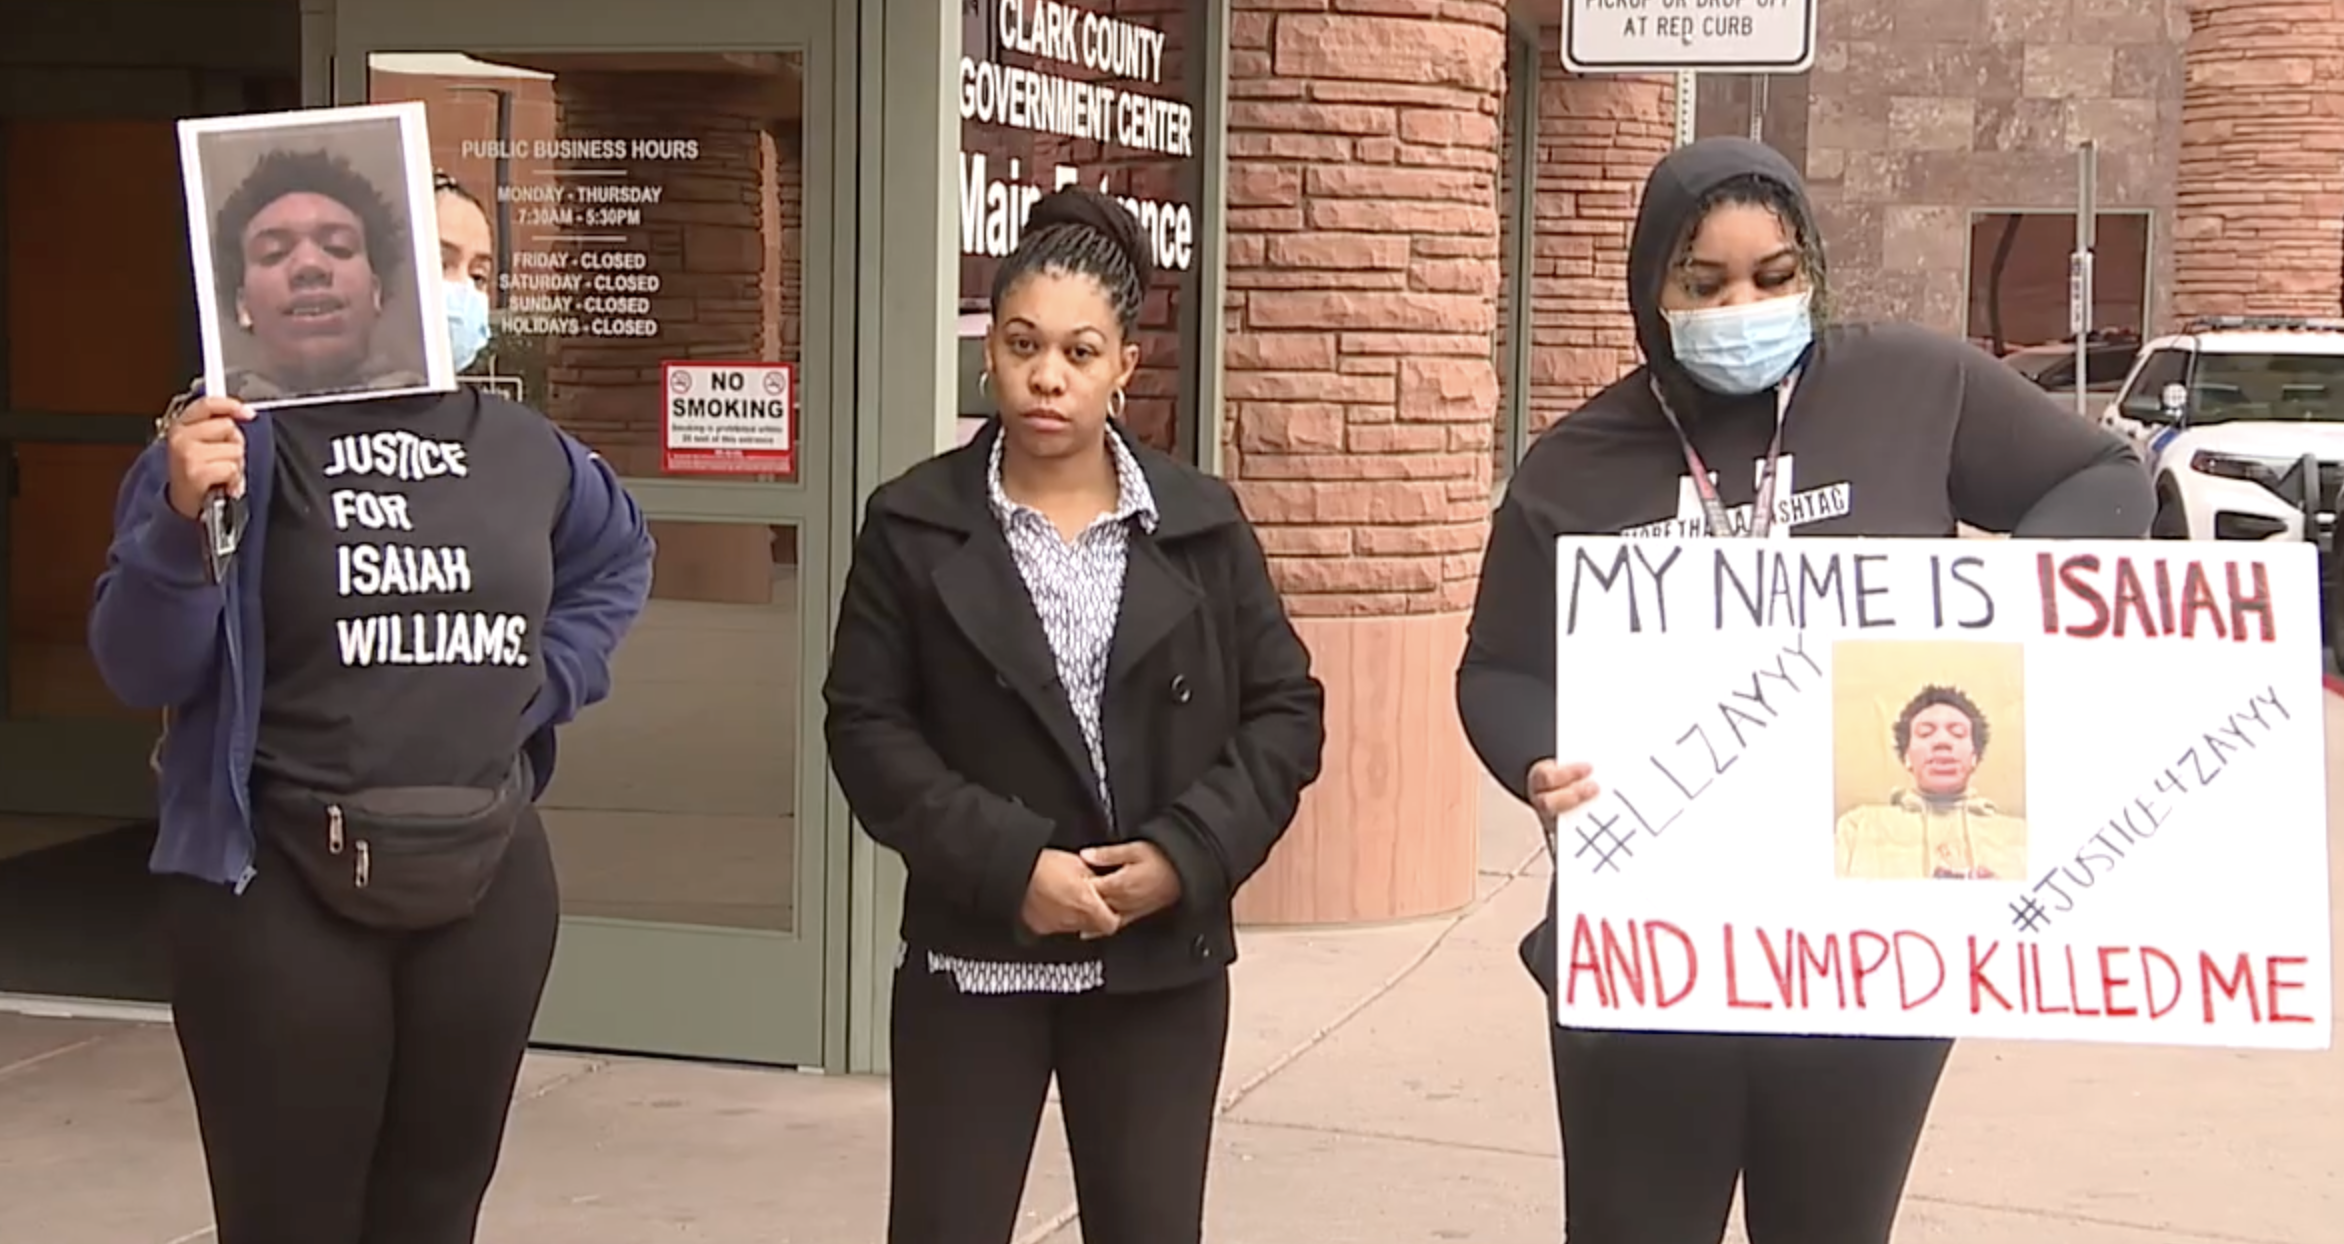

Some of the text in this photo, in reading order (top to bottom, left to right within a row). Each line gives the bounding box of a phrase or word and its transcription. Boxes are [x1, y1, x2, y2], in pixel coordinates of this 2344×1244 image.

[1624, 16, 1753, 37] AT RED CURB
[1000, 0, 1165, 84] CLARK COUNTY
[960, 56, 1193, 157] GOVERNMENT CENTER
[461, 139, 699, 160] PUBLIC BUSINESS HOURS
[498, 186, 564, 203] MONDAY
[577, 186, 662, 203] THURSDAY
[518, 208, 574, 225] 7:30AM
[585, 208, 641, 226] 5:30PM
[513, 252, 568, 269] FRIDAY
[580, 252, 646, 270] CLOSED
[500, 273, 582, 291] SATURDAY
[594, 274, 660, 292] CLOSED
[509, 295, 573, 313] SUNDAY
[584, 296, 650, 314] CLOSED
[502, 317, 579, 335] HOLIDAYS
[592, 318, 658, 336] CLOSED
[711, 371, 745, 391] NO
[673, 397, 784, 419] SMOKING
[324, 430, 469, 481] JUSTICE
[332, 489, 413, 531] FOR
[338, 544, 471, 596] ISAIAH
[1566, 544, 2277, 643] MY NAME IS ISAIAH
[337, 611, 529, 667] WILLIAMS.
[2008, 685, 2291, 934] #JUSTICE4ZAYYY
[1567, 912, 2316, 1024] AND LVMPD KILLED ME
